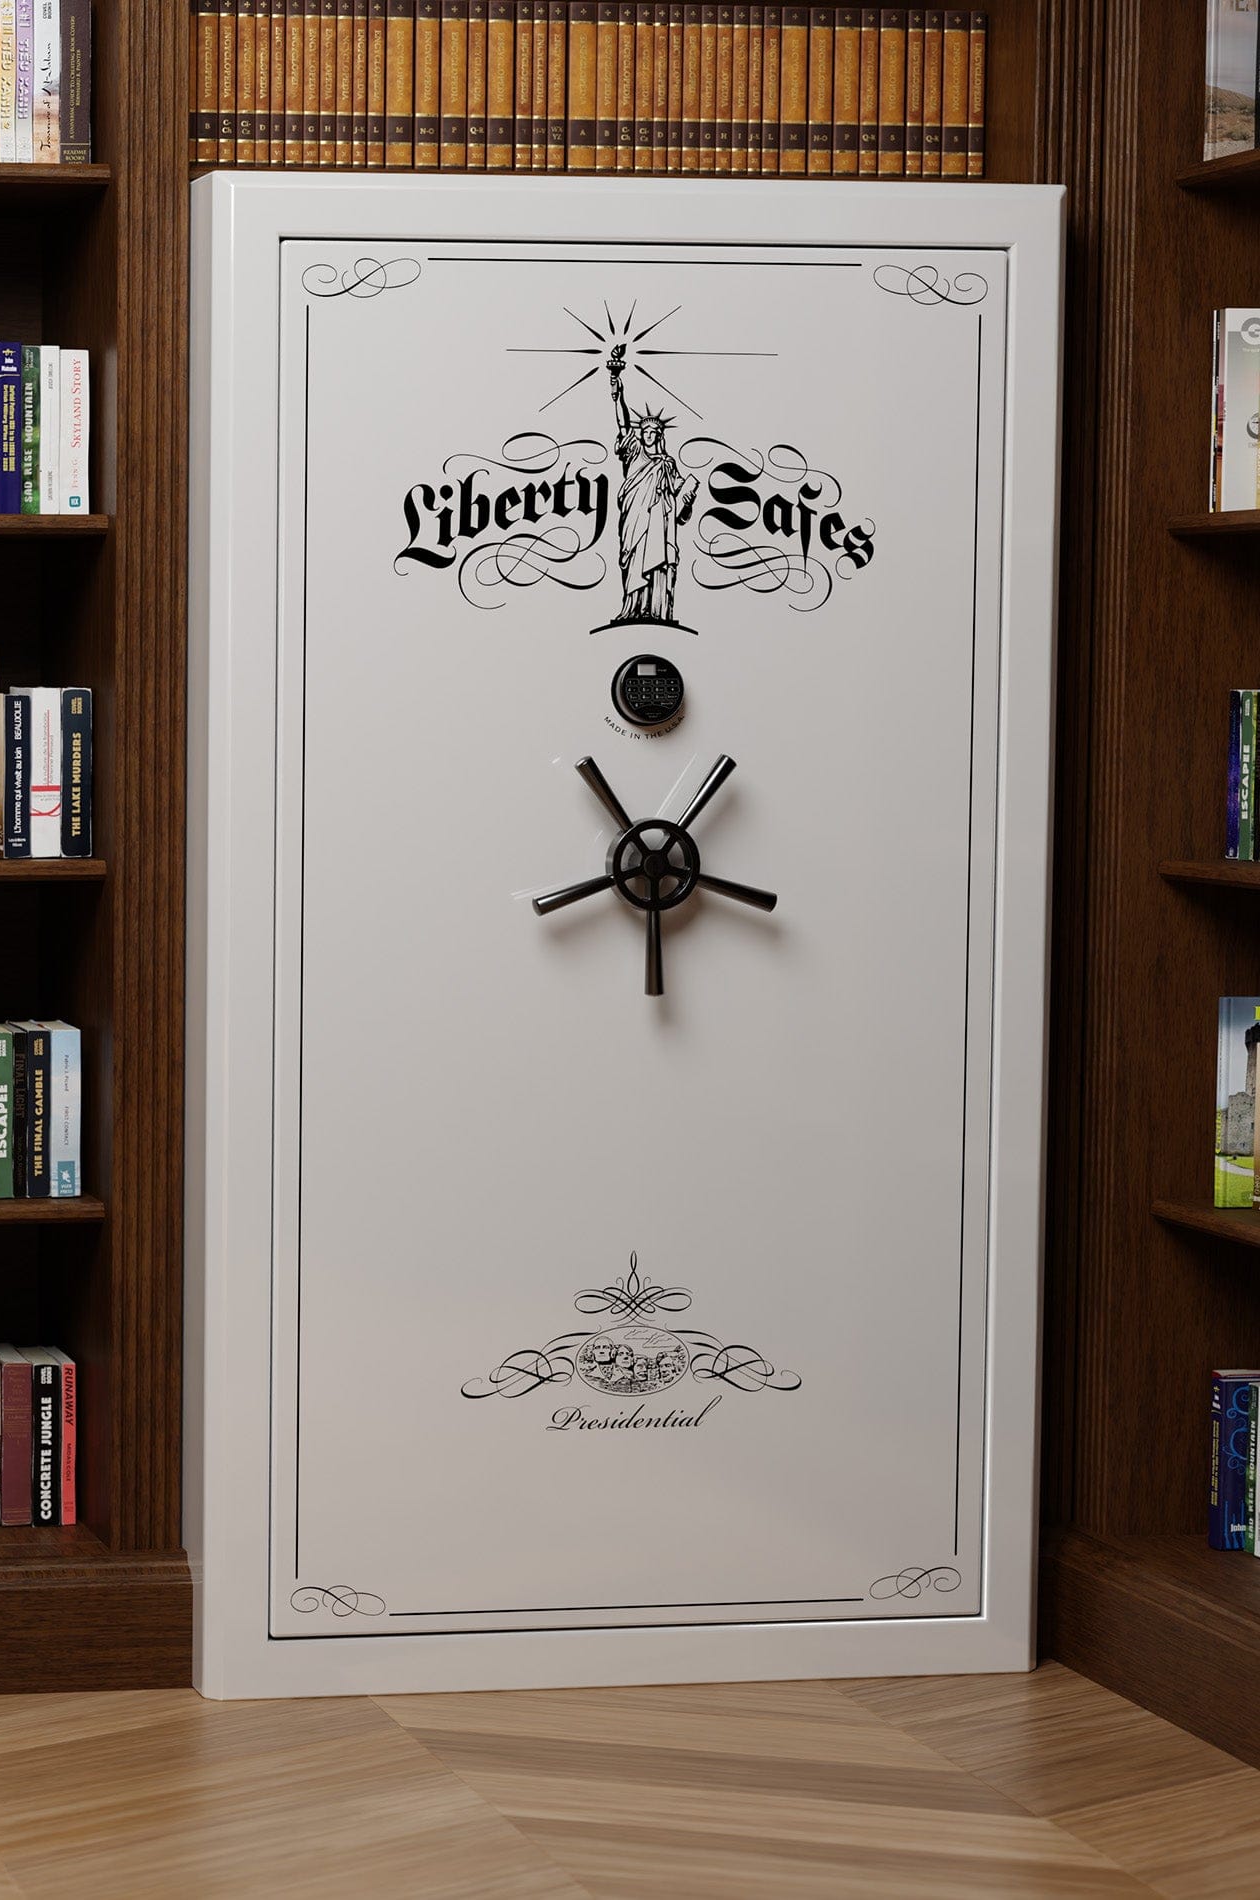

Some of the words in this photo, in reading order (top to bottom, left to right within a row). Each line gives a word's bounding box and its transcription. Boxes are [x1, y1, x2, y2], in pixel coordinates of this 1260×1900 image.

[224, 26, 232, 97] ENCYCLOPEDIA
[71, 359, 82, 394] STORY
[24, 382, 33, 443] MOUNTAIN
[71, 397, 82, 448] SKYLAND
[24, 448, 33, 475] RISE
[24, 481, 33, 503] SAD
[394, 462, 609, 576] Liberty
[699, 462, 875, 579] Safes
[604, 716, 628, 737] MADE
[630, 732, 641, 740] IN
[645, 730, 663, 740] THE
[72, 733, 81, 785] MURDERS
[1242, 745, 1250, 820] ESCAPEE
[72, 787, 81, 814] LAKE
[72, 818, 81, 838] THE
[16, 1053, 26, 1084] FINAL
[16, 1087, 26, 1118] LIGHT
[34, 1069, 43, 1115] GAMBLE
[34, 1119, 43, 1151] FINAL
[34, 1155, 43, 1176] THE
[64, 1367, 73, 1426] RUNAWAY
[545, 1395, 722, 1431] Presidential
[40, 1397, 52, 1445] JUNGLE
[40, 1449, 52, 1520] CONCRETE
[1230, 1523, 1246, 1532] John
